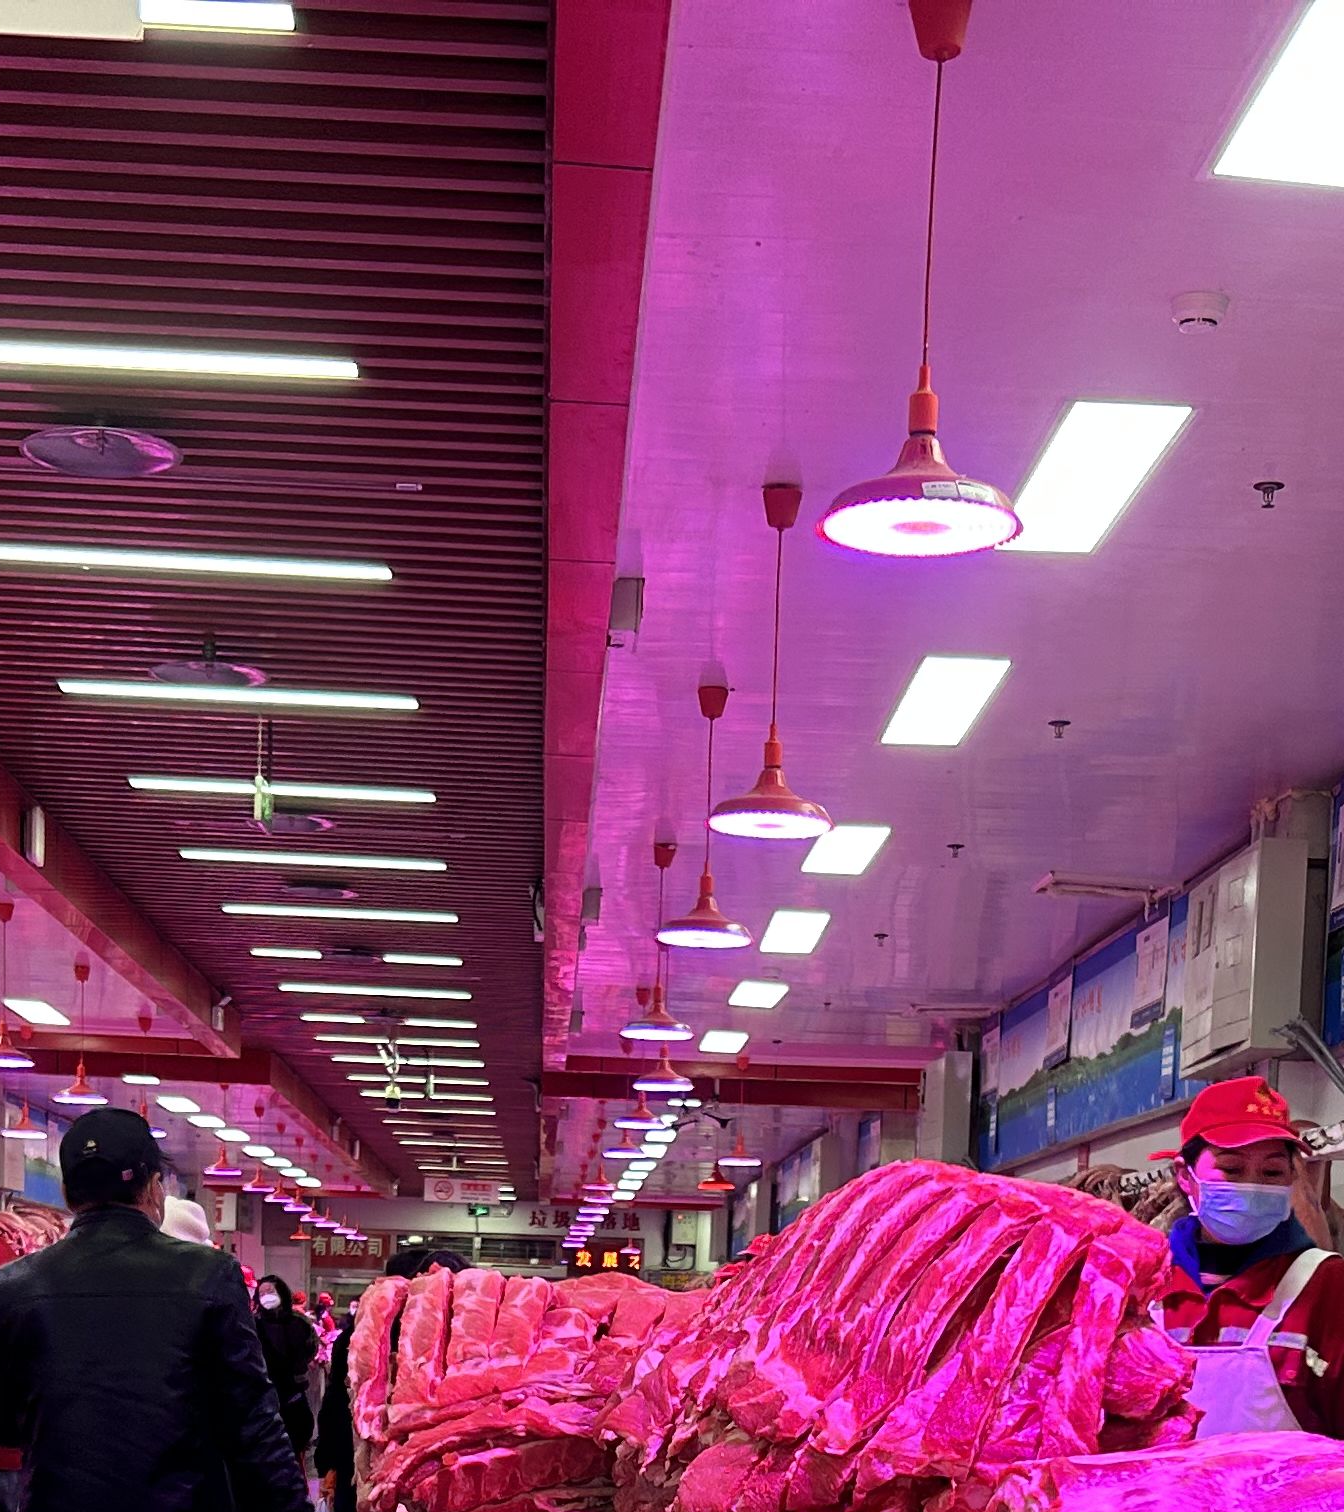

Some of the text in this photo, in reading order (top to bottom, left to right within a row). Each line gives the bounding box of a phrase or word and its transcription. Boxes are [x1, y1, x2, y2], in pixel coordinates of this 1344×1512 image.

[528, 1209, 641, 1231] 垃圾落地
[312, 1235, 384, 1258] 有限公司
